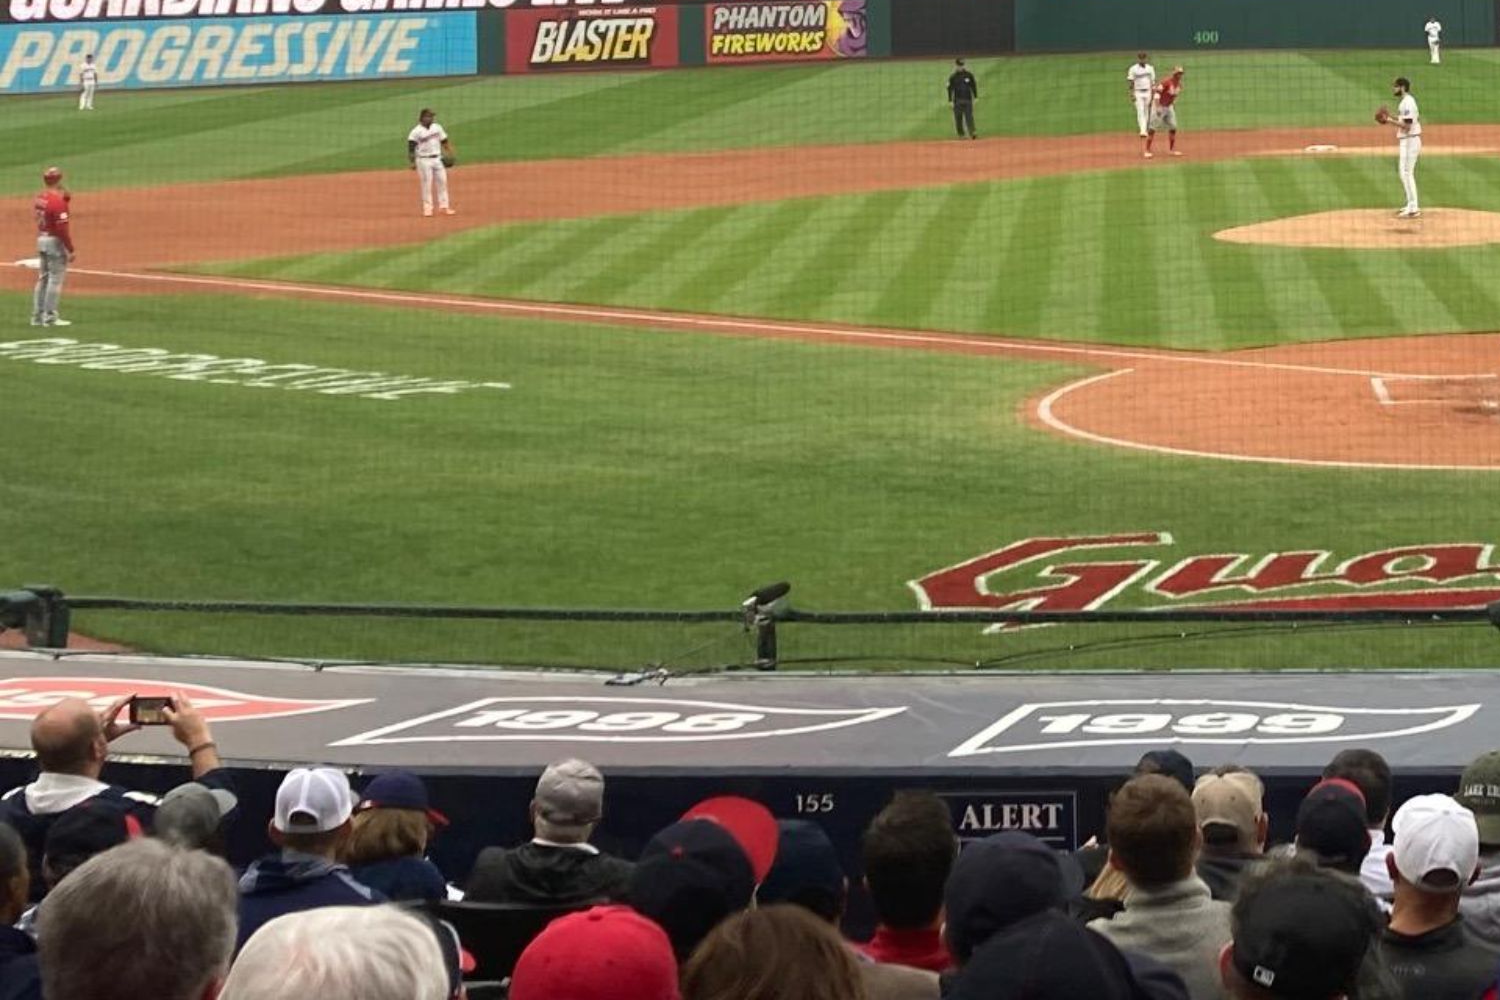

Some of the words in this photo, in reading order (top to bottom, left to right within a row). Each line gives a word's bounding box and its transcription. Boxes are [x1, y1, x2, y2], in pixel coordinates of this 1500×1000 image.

[713, 4, 826, 30] PHANTOM
[530, 18, 654, 64] BLASTER
[711, 31, 824, 54] FIREWORKS
[1193, 31, 1219, 44] 400
[0, 18, 427, 90] PROGRESSIVE
[454, 708, 767, 732] 1998
[1039, 712, 1344, 734] 1999
[796, 793, 834, 812] 155
[961, 803, 1064, 830] ALERT
